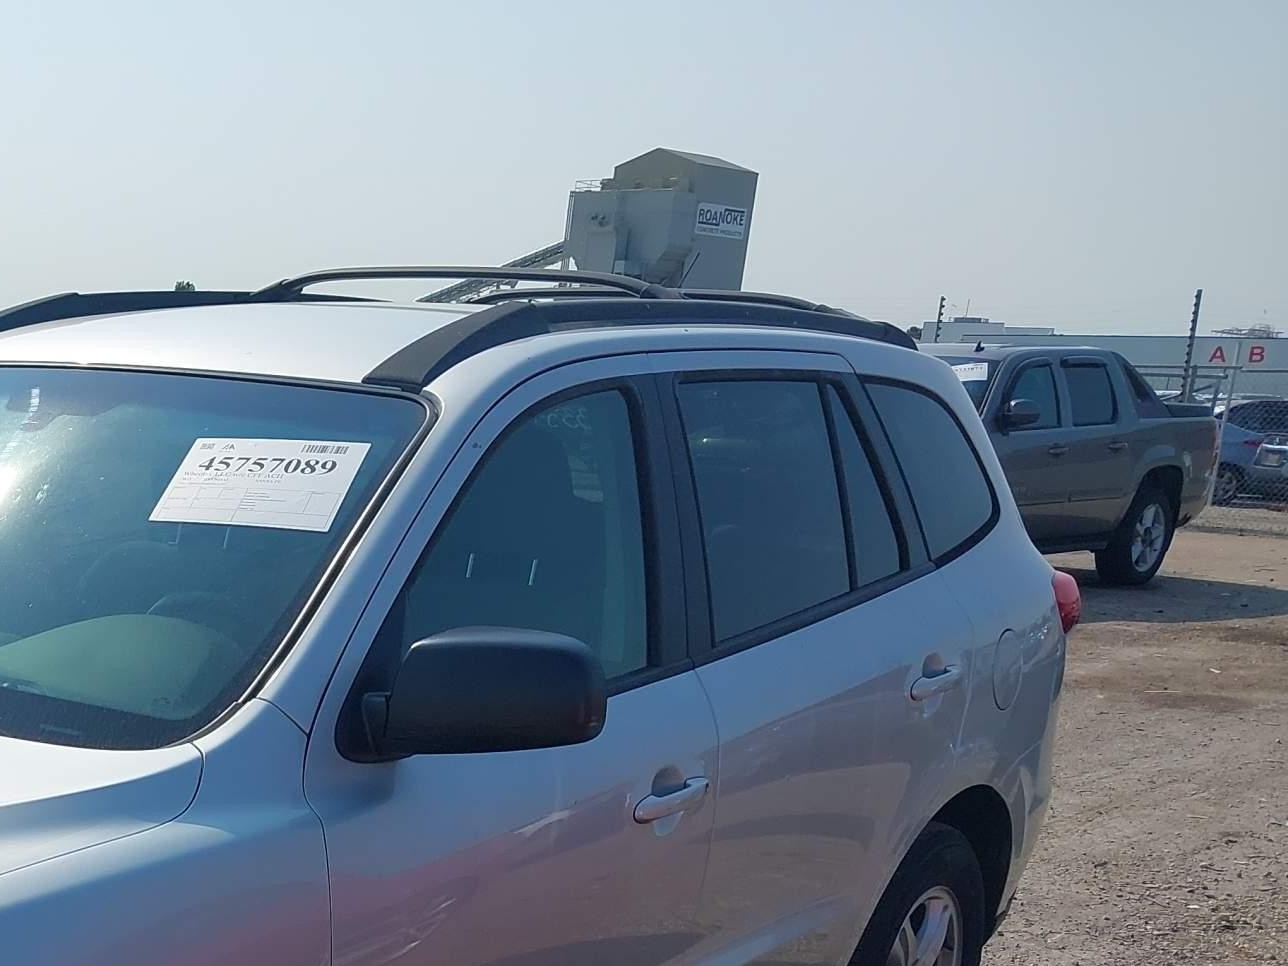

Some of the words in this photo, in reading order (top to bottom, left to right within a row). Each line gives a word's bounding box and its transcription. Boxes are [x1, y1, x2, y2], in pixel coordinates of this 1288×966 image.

[698, 208, 745, 226] ROANOKE
[1208, 346, 1226, 363] A
[1248, 346, 1265, 363] B
[198, 456, 338, 476] 45757089
